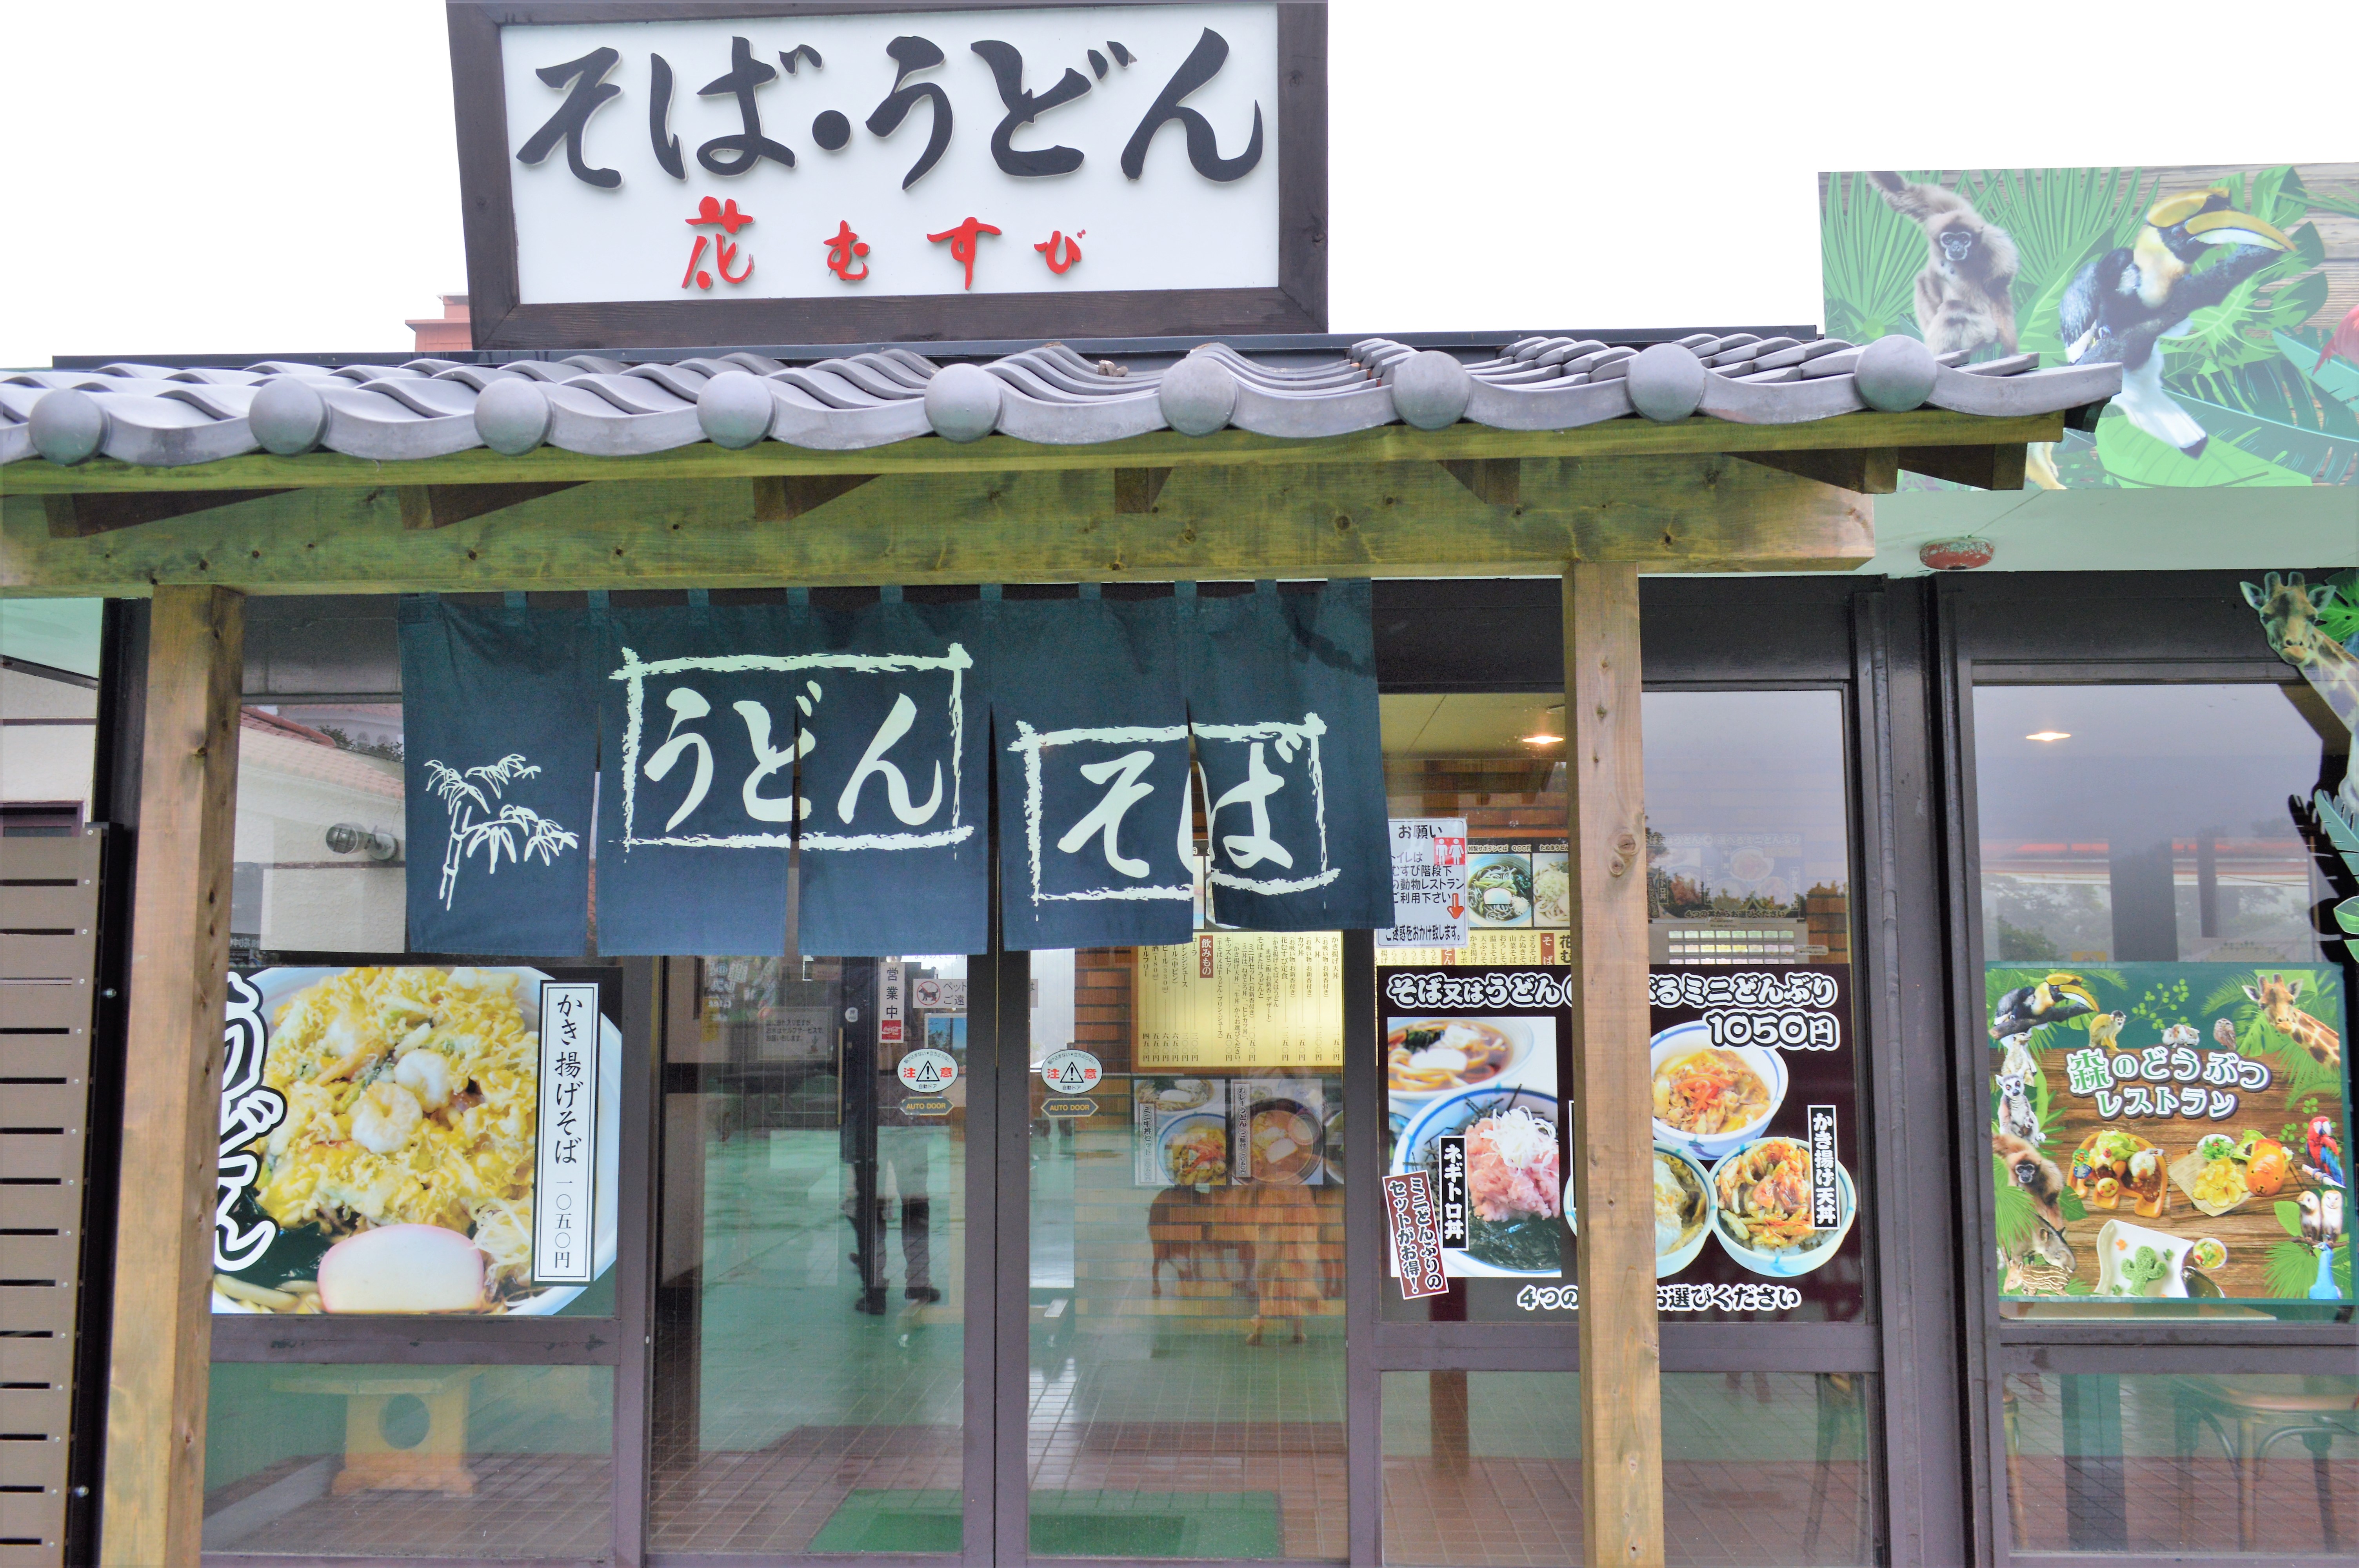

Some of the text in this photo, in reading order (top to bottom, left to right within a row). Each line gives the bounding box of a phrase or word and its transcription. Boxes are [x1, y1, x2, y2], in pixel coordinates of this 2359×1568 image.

[516, 27, 1263, 191] そば・うどん
[682, 196, 1086, 290] 花むすび
[643, 679, 942, 831] うどん
[1058, 731, 1302, 878] そば
[1399, 825, 1443, 839] お願い
[1393, 878, 1465, 890] の動物レストラン
[886, 967, 898, 1019] 営業中
[1201, 938, 1211, 975] 飲みもの
[1388, 973, 1564, 1007] そば又はうどん
[1705, 1010, 1839, 1049] 1050円
[2066, 1045, 2269, 1094] 森のどうぶつ
[2095, 1086, 2237, 1118] レストラン
[554, 993, 583, 1269] かき揚げそば 一〇五〇円
[1444, 1144, 1464, 1240] ネギトロ丼
[1813, 1112, 1836, 1224] かき揚げ天丼
[1410, 1177, 1444, 1290] ミニどんぶりの
